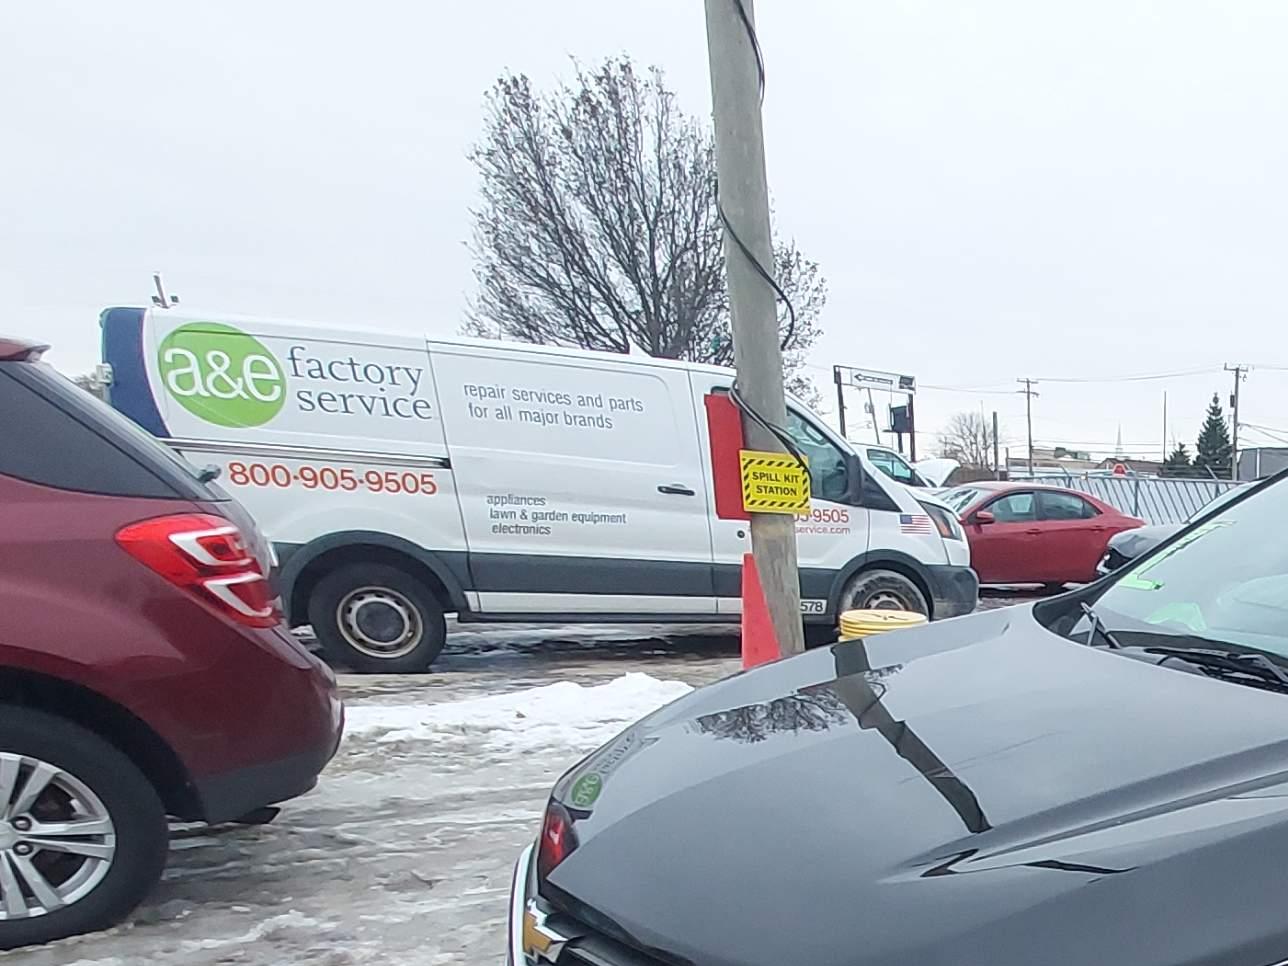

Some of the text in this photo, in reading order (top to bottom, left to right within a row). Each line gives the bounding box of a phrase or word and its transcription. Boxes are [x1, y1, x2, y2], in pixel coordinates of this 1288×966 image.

[164, 348, 281, 401] a&e
[288, 346, 424, 395] factory
[296, 387, 433, 420] service
[464, 384, 644, 412] repair services and parts
[468, 402, 614, 430] for all major brands
[752, 471, 800, 483] SPILL KIT
[486, 494, 547, 507] appliances
[756, 485, 798, 496] STATION
[489, 507, 628, 525] lawn & garden equipment
[491, 523, 552, 535] electronics
